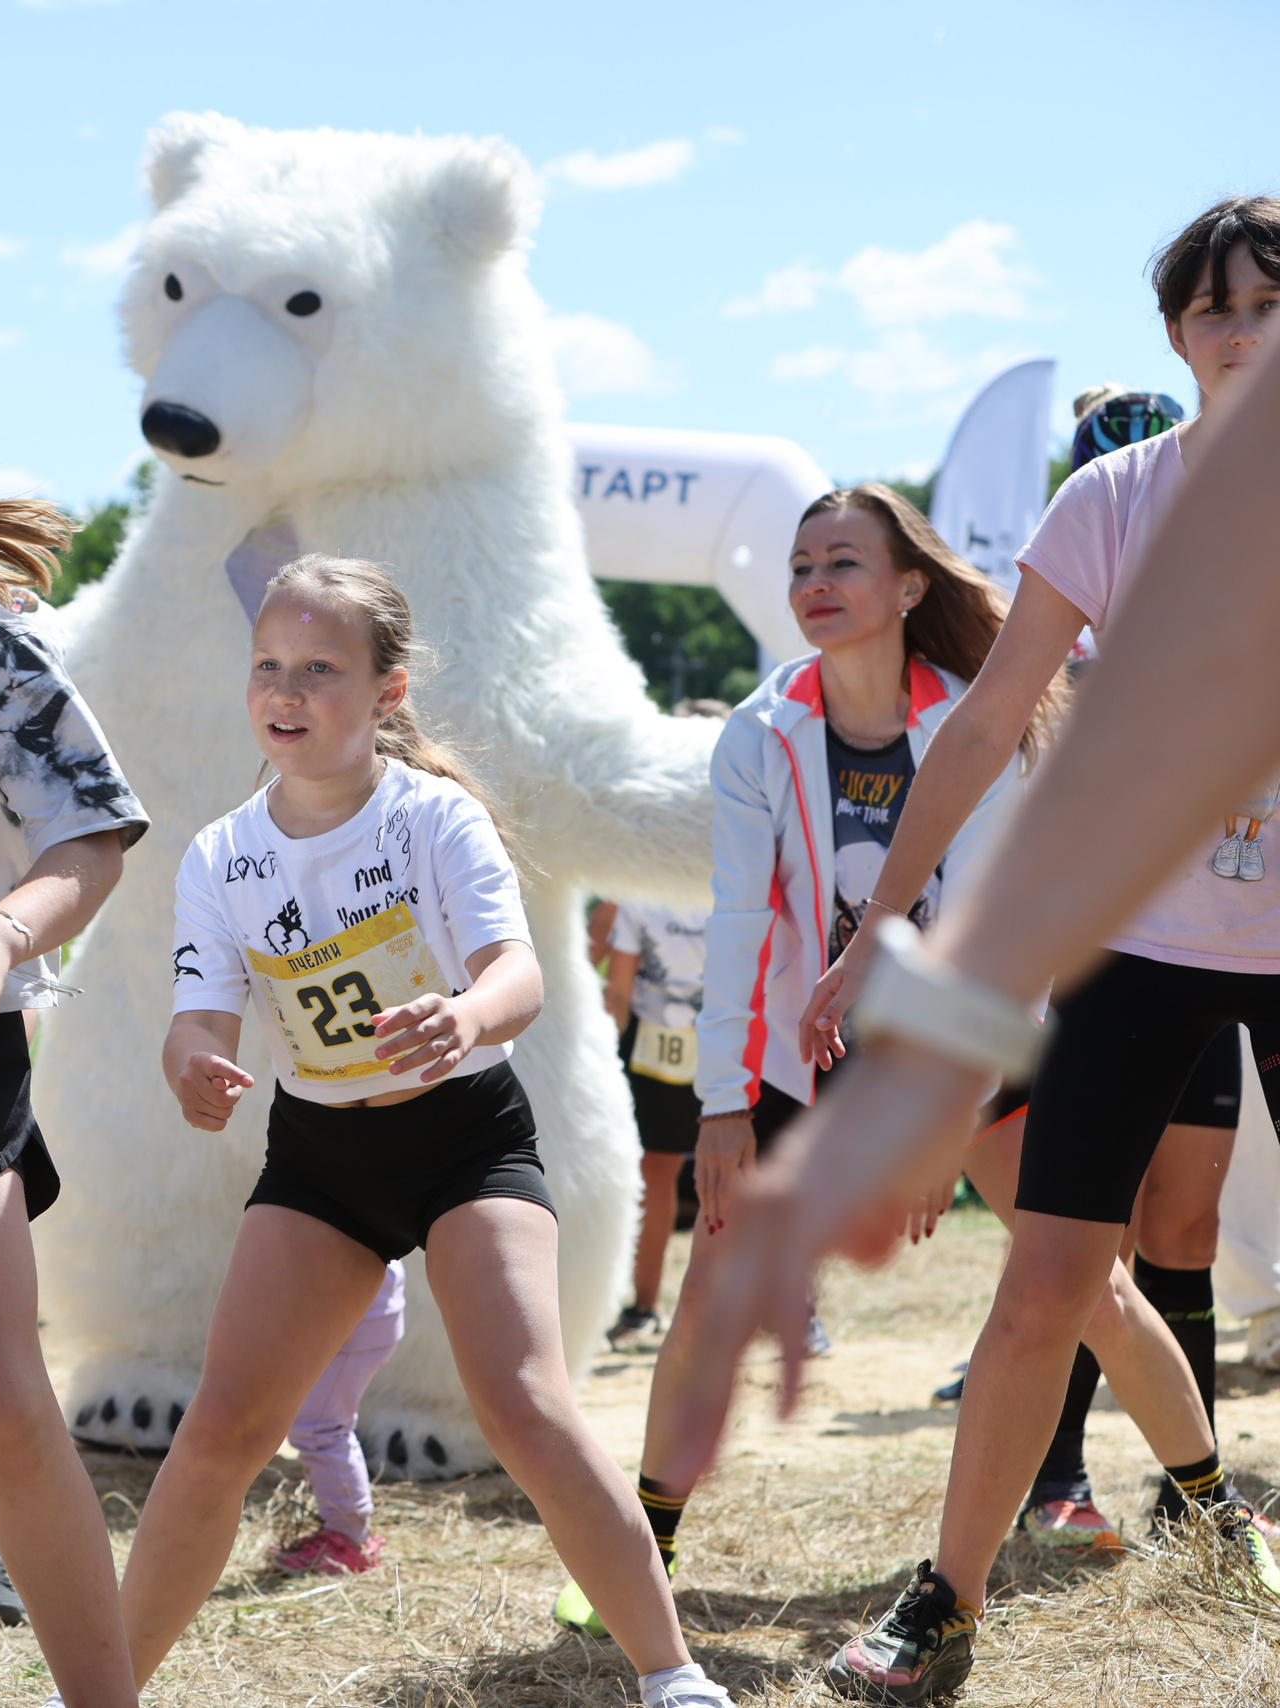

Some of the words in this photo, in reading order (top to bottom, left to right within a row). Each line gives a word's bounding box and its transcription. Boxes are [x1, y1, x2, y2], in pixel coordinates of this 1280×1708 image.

[580, 465, 701, 505] ТАРТ
[839, 769, 904, 808] LUCKY
[287, 941, 342, 974] ПЧЁЛКИ
[297, 970, 382, 1047] 23
[658, 1034, 684, 1065] 18
